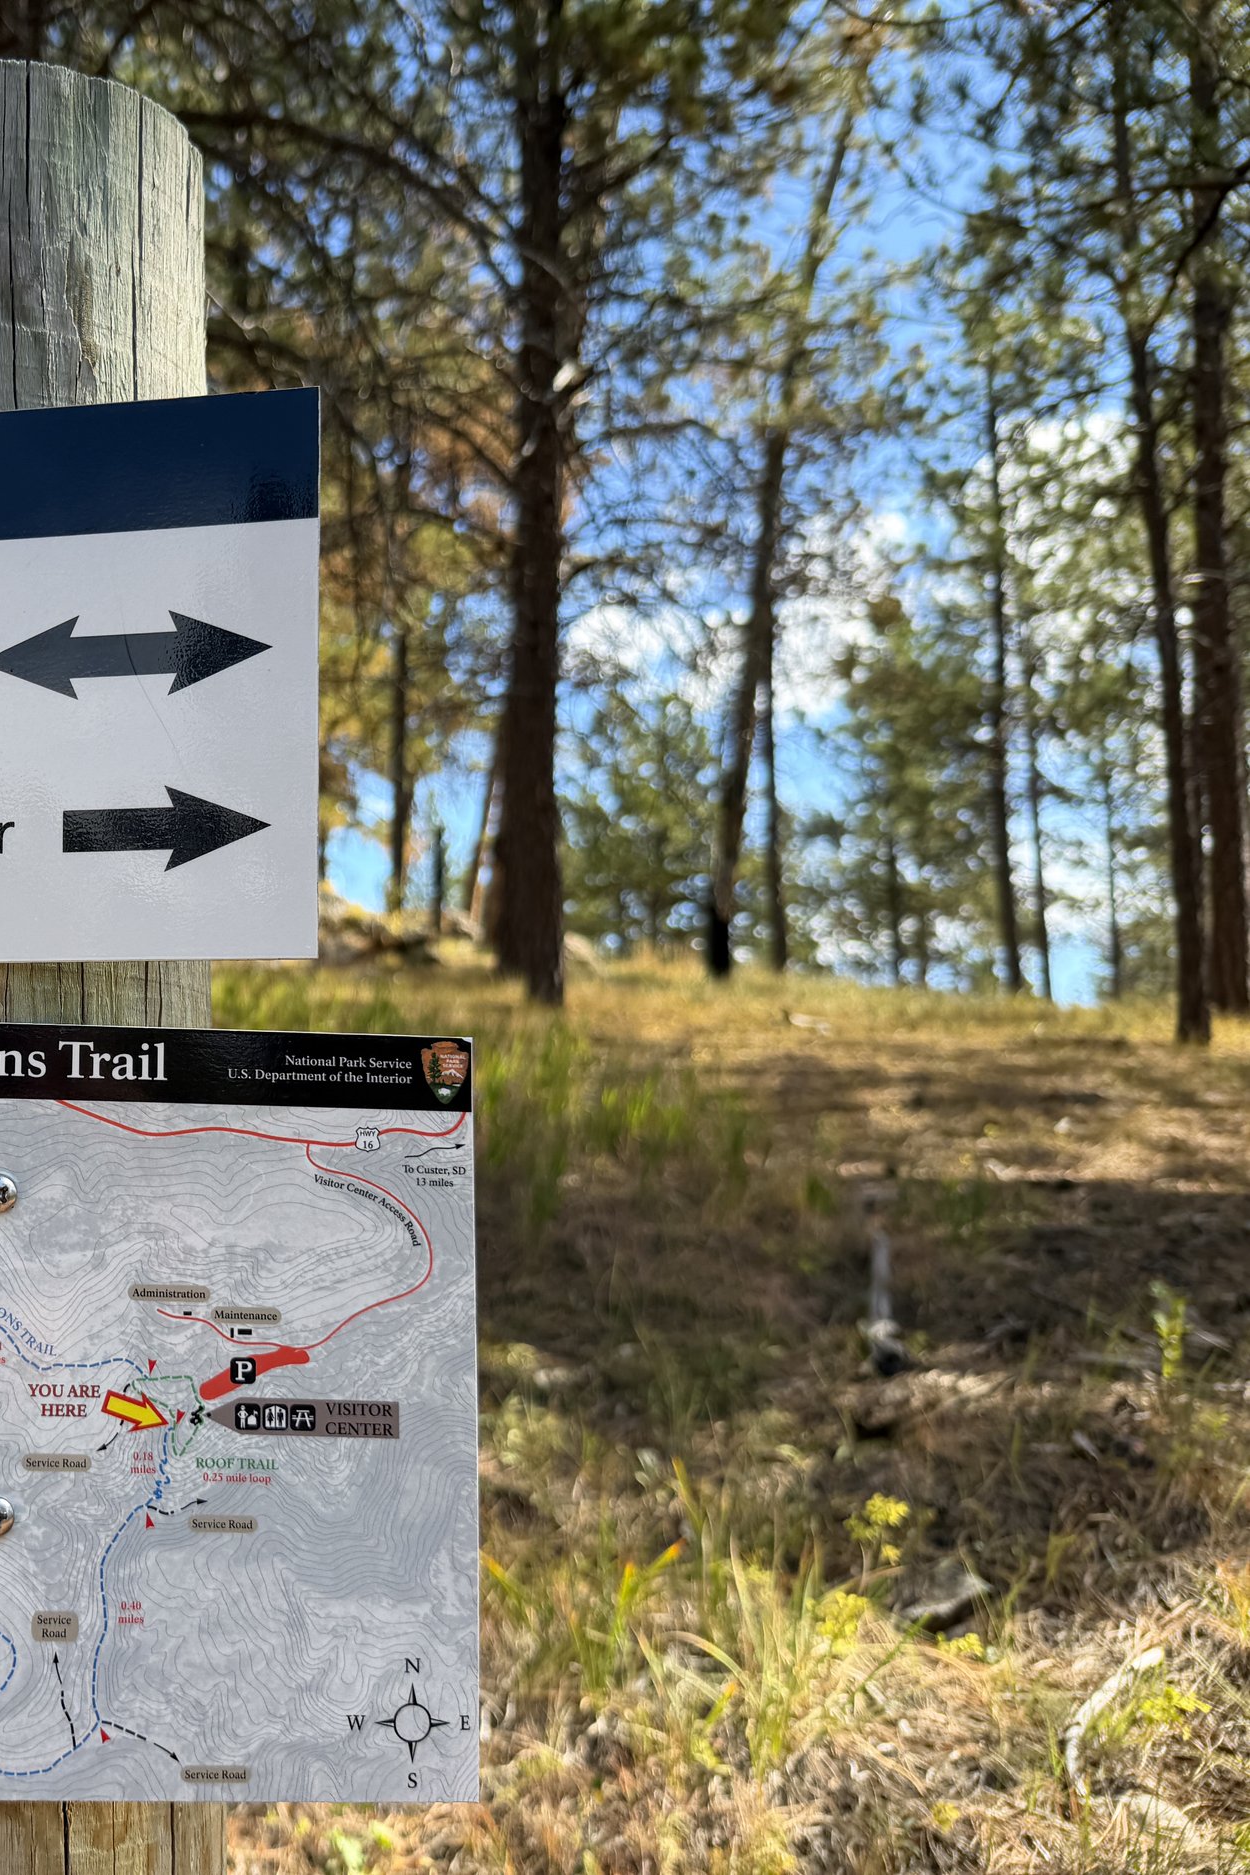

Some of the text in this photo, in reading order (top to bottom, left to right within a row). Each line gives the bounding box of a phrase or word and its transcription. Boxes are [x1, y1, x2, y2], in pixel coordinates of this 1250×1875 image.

[59, 1040, 168, 1081] Trail
[285, 1055, 412, 1069] National Park Service
[228, 1069, 412, 1084] U.S. Department of the Interior
[363, 1141, 373, 1149] 16
[402, 1165, 466, 1175] To Custer, SD
[416, 1178, 453, 1187] 13 miles
[314, 1174, 421, 1247] Visitor Center Access Road
[132, 1288, 206, 1300] Administration
[214, 1310, 278, 1321] Maintenance
[20, 1328, 57, 1356] TRAIL
[235, 1361, 253, 1380] P
[28, 1384, 101, 1398] YOU ARE
[41, 1404, 87, 1417] HERE
[326, 1402, 392, 1417] VISITOR
[325, 1422, 393, 1436] CENTER
[133, 1452, 153, 1461] 0.18
[26, 1457, 87, 1469] Service Road
[196, 1457, 279, 1470] ROOF TRAIL
[130, 1465, 156, 1474] miles
[203, 1473, 271, 1485] 0.25 mile loop
[192, 1519, 253, 1531] Service Road
[121, 1601, 142, 1611] 0.40
[37, 1615, 72, 1626] Service
[118, 1614, 144, 1624] miles
[41, 1628, 67, 1639] Road
[405, 1658, 420, 1674] N
[346, 1716, 365, 1730] W
[460, 1716, 470, 1730] E
[184, 1769, 246, 1781] Service Road
[407, 1773, 418, 1788] S
